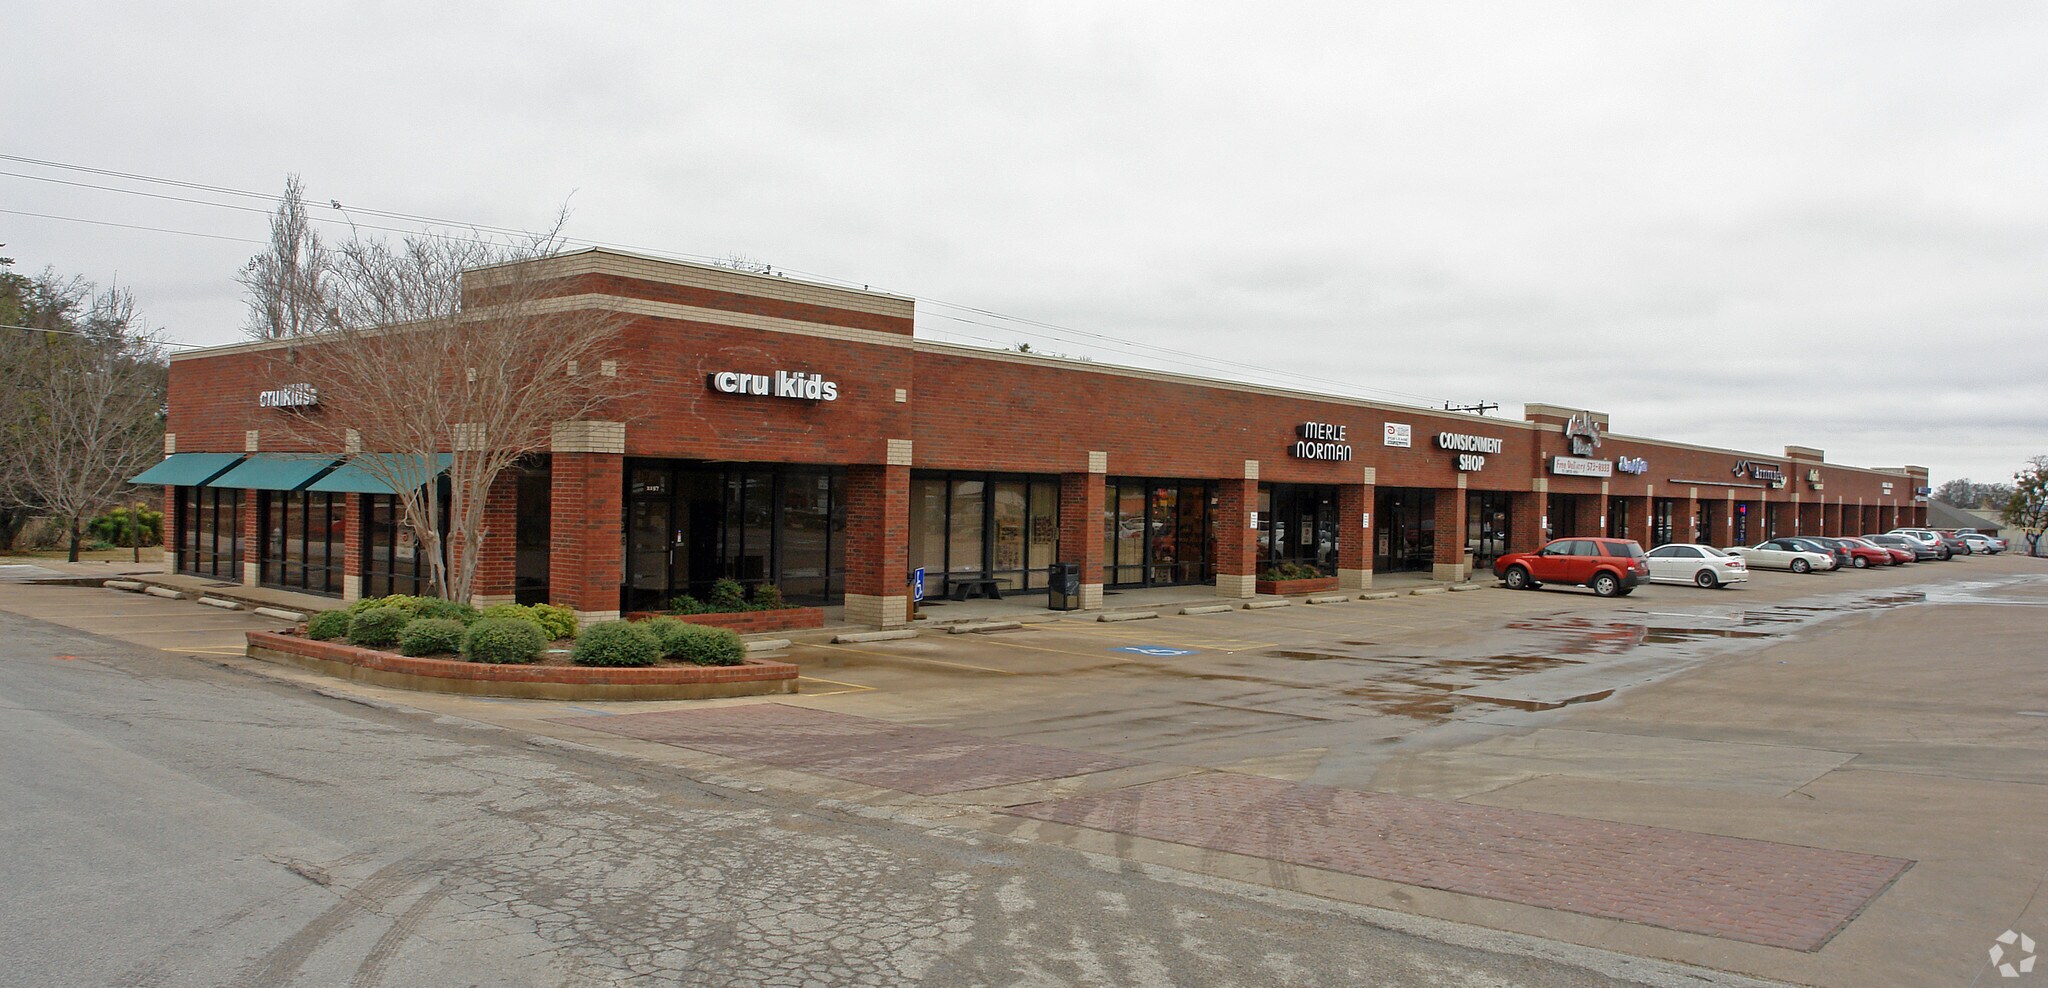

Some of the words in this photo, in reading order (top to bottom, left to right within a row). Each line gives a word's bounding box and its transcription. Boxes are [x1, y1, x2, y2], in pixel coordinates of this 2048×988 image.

[715, 371, 769, 396] cru
[775, 370, 838, 401] kids
[259, 390, 280, 407] cru
[1304, 421, 1346, 441] MERLE
[1296, 441, 1352, 461] NORMAN
[1438, 431, 1503, 454] CONSIGNMENT
[1459, 453, 1485, 472] SHOP
